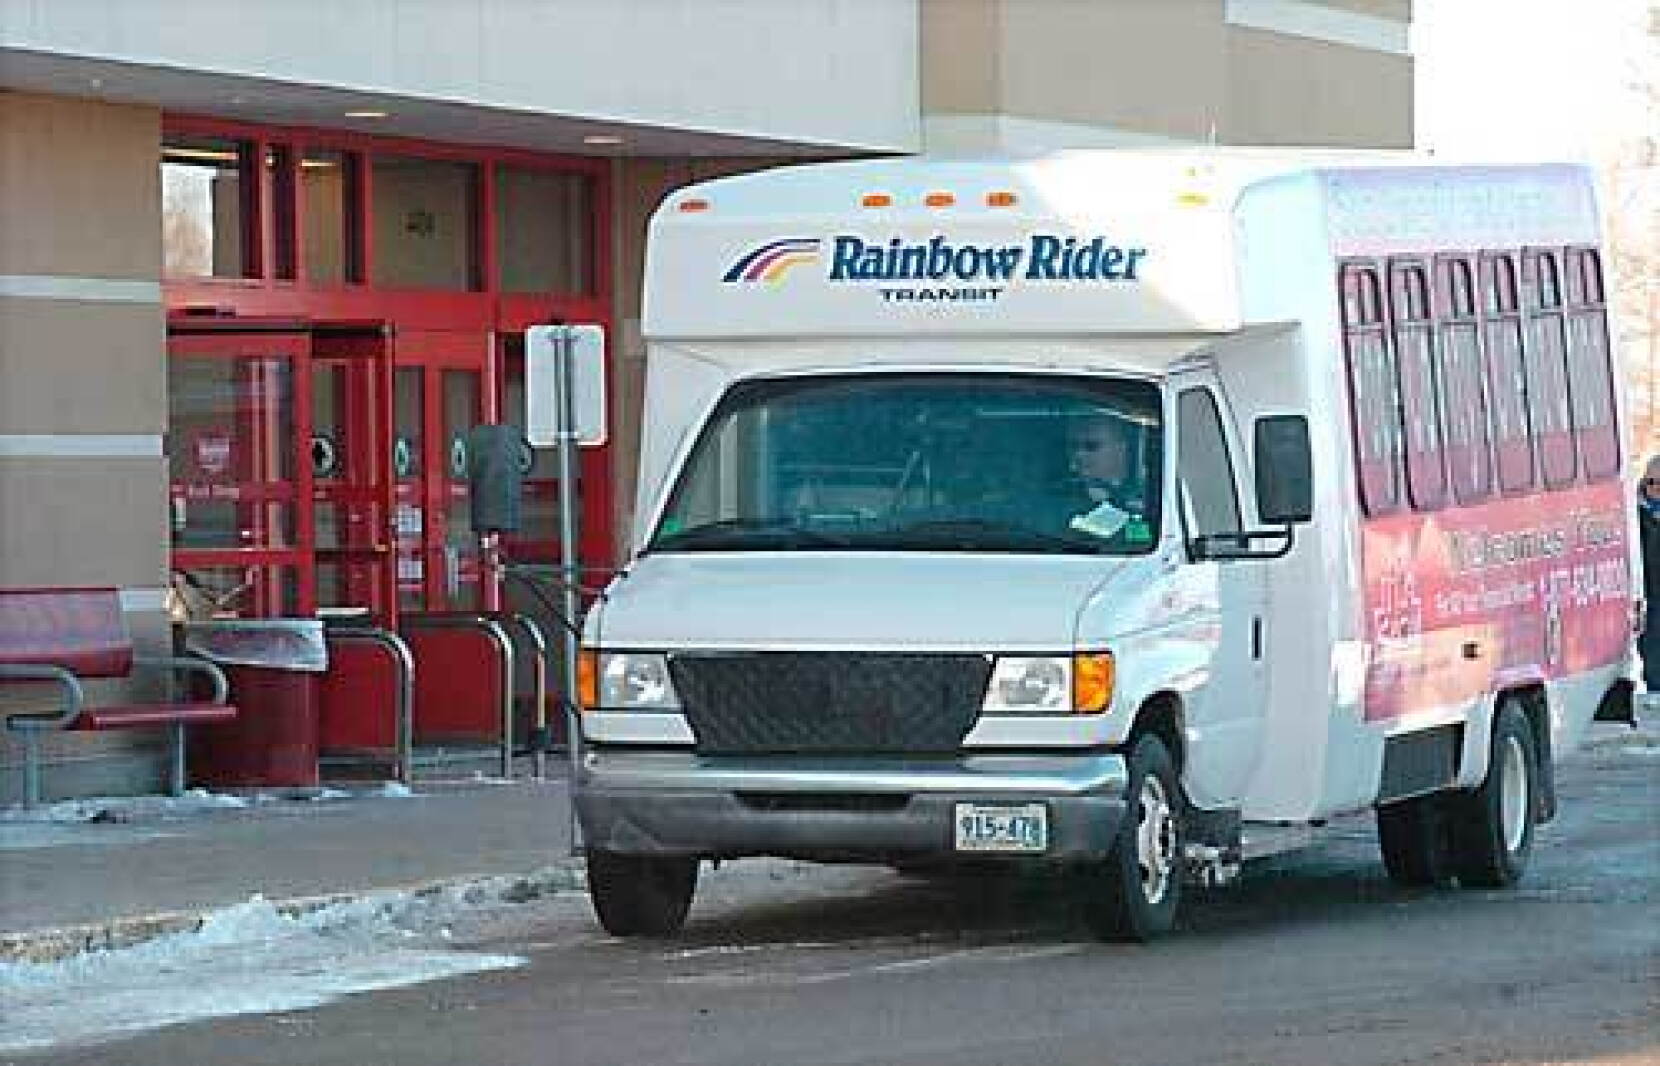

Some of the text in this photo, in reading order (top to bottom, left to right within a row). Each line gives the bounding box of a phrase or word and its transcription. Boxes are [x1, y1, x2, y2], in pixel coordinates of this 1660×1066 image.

[829, 235, 1147, 281] Rainbow Rider
[880, 288, 1004, 303] TRANSIT
